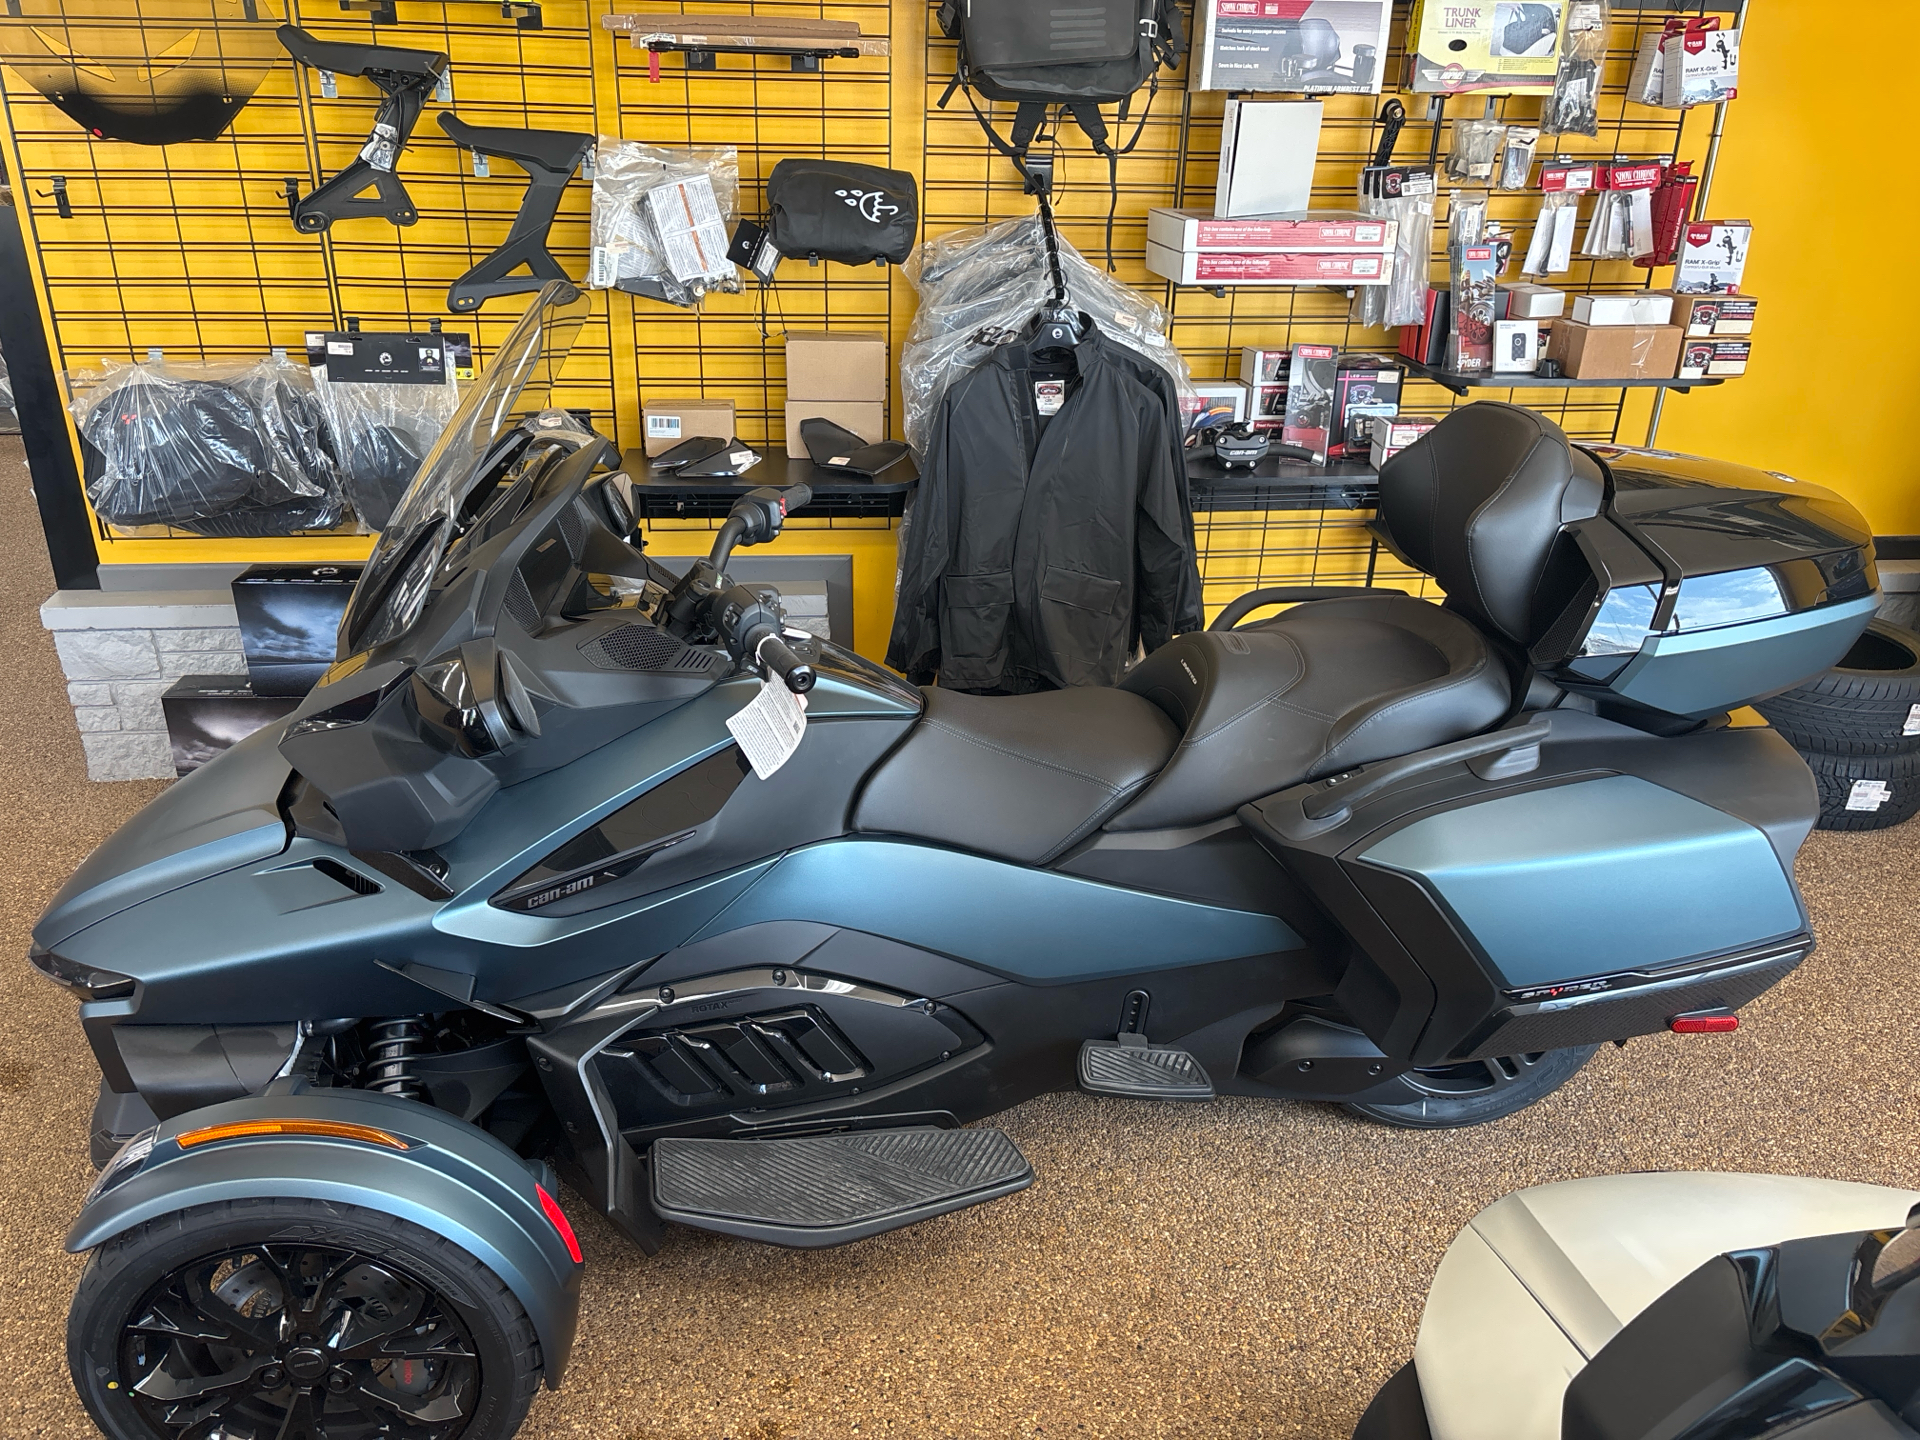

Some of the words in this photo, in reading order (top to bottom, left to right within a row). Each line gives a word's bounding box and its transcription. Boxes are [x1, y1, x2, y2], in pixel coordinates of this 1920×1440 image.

[1444, 8, 1481, 17] TRUNK
[1446, 18, 1476, 28] LINER
[1615, 170, 1632, 183] SHOW
[1633, 169, 1658, 181] CHROME
[1456, 358, 1481, 368] SPYDER
[1180, 658, 1198, 684] LIMITED
[527, 875, 594, 908] can-am
[1520, 980, 1607, 999] SPYDER
[690, 1001, 728, 1013] ROTAX
[397, 1254, 459, 1297] ROADSTER
